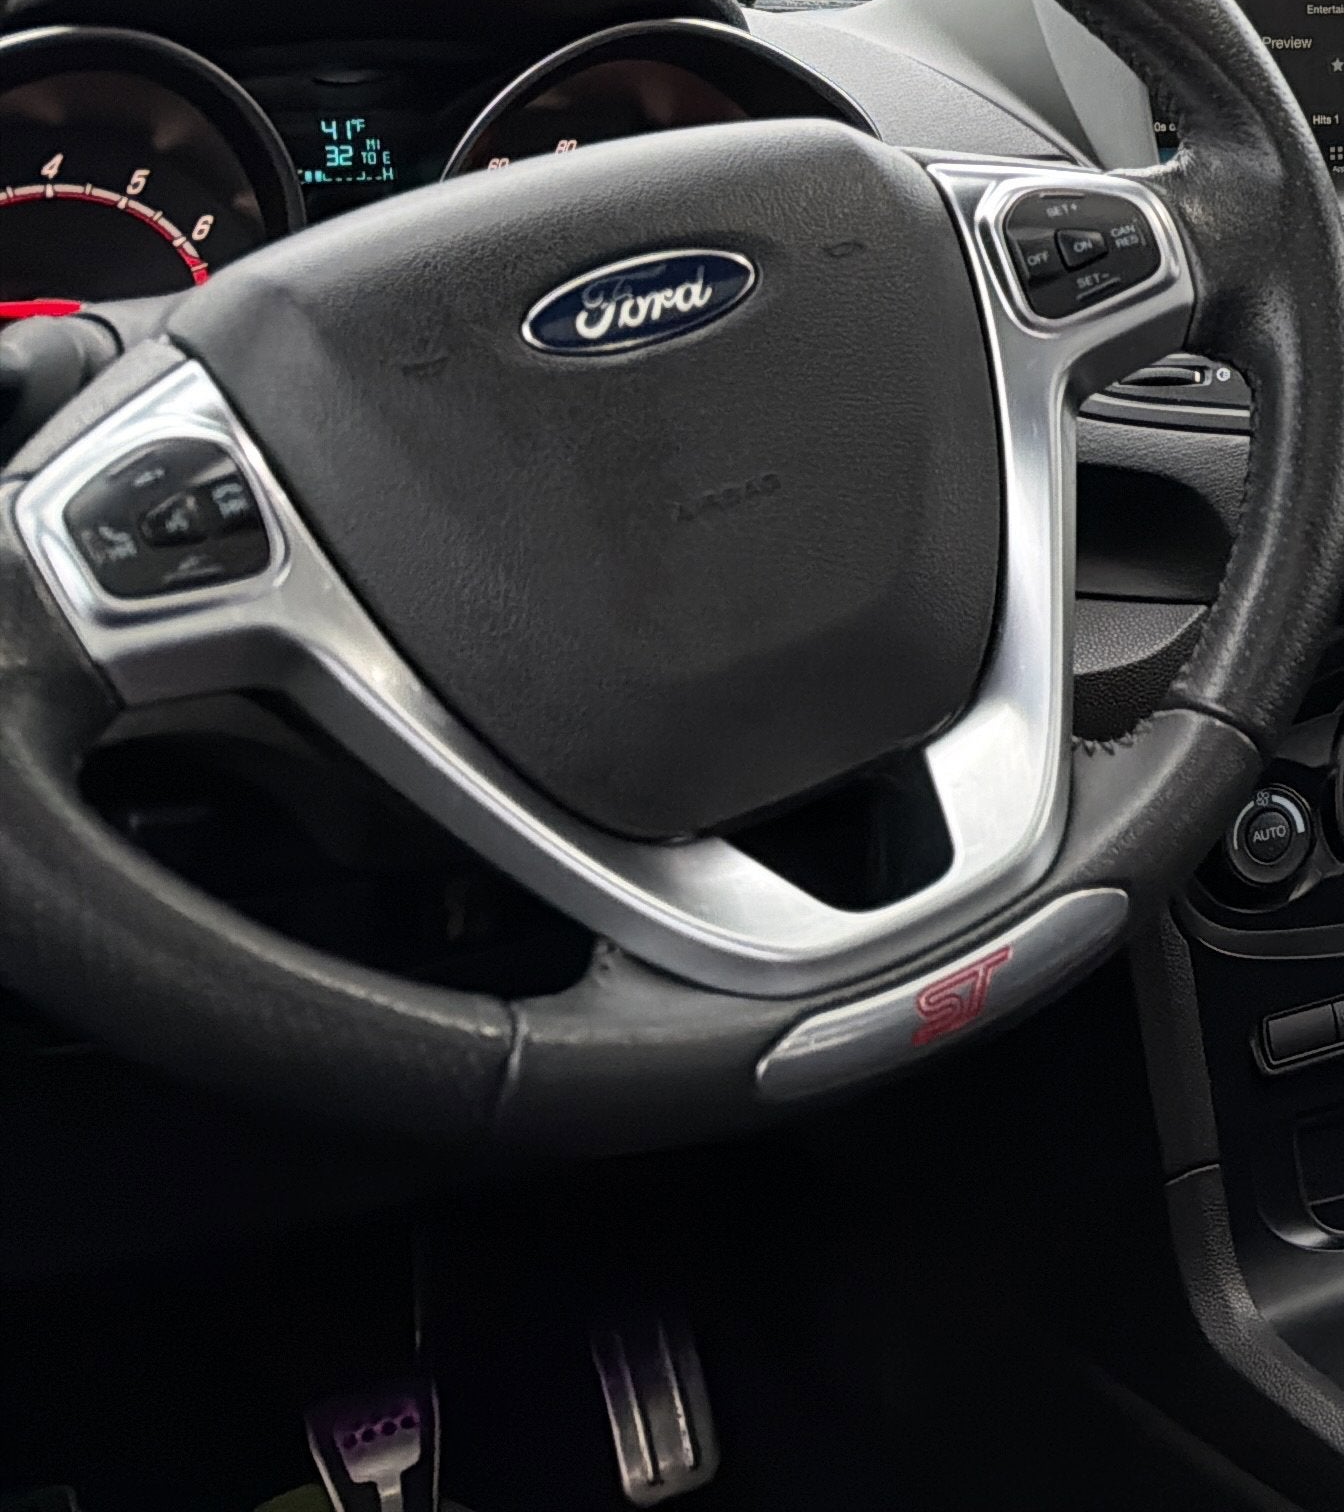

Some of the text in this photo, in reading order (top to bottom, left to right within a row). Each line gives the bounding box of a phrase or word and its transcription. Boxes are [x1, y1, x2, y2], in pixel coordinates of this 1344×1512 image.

[1262, 37, 1313, 49] Preview
[1312, 115, 1334, 124] Hits
[366, 138, 381, 150] MI
[325, 145, 391, 166] 32 TO E
[40, 152, 64, 179] 4
[126, 169, 151, 195] 5
[191, 214, 214, 241] 6
[1110, 224, 1136, 238] CAN
[1073, 240, 1093, 253] ON
[1115, 235, 1140, 249] RES
[1027, 251, 1049, 266] OFF
[574, 264, 713, 339] Ford
[1252, 824, 1287, 844] AUTO
[912, 944, 1014, 1046] ST
